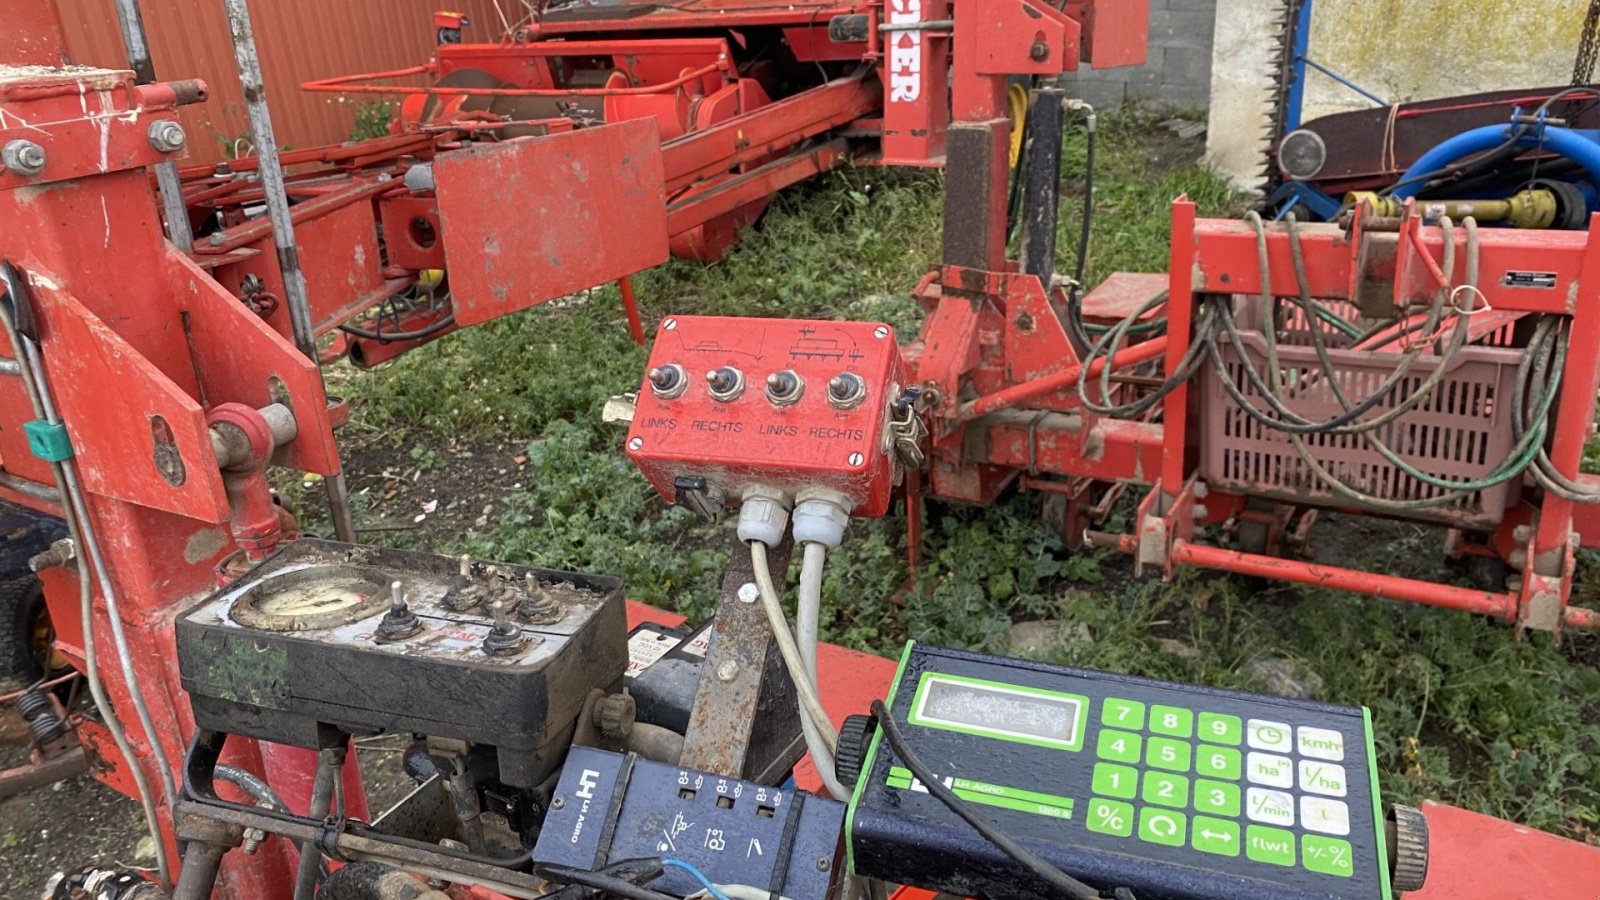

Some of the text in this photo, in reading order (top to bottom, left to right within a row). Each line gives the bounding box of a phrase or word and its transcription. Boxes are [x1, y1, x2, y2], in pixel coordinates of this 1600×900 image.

[641, 418, 863, 441] LINKS RECHTS LINKS RECHTS
[1117, 706, 1131, 721] 7
[1163, 713, 1178, 728] 8
[1212, 720, 1227, 735] 9
[1110, 739, 1126, 754] 4
[1161, 746, 1176, 762] 5
[1211, 754, 1226, 770] 6
[575, 769, 600, 799] LH
[955, 779, 971, 789] LH
[1109, 773, 1120, 789] 1
[1158, 781, 1174, 797] 2
[1209, 789, 1225, 806] 3
[571, 799, 590, 844] LH AGRO
[1252, 836, 1289, 855] flwt
